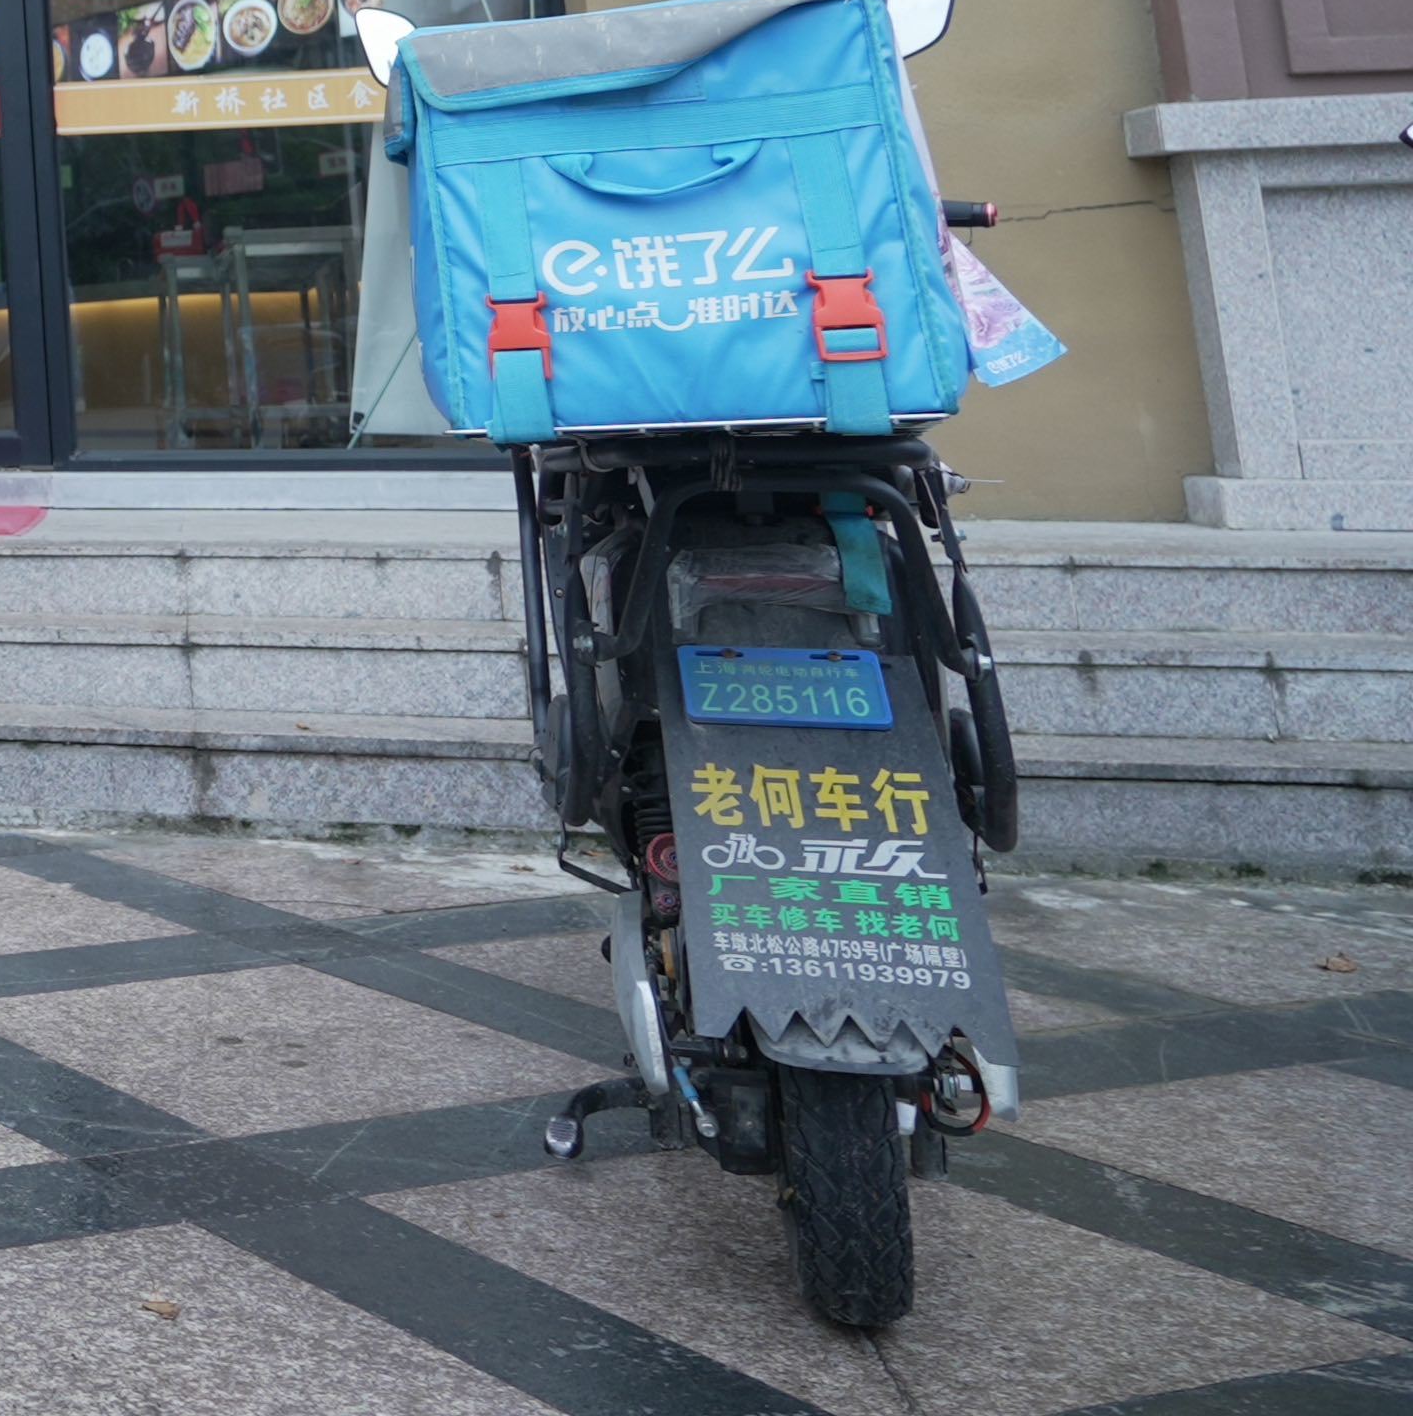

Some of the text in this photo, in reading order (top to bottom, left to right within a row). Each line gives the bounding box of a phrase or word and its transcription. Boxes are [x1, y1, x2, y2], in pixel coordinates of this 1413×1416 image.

[172, 80, 380, 117] 新桥社区食
[612, 226, 795, 290] 饿了么
[552, 290, 799, 333] 放心点 准时达
[699, 683, 870, 717] Z285116
[691, 762, 930, 836] 老何车行
[707, 874, 953, 910] 厂家直销
[710, 903, 961, 942] 买车修车 找老何
[713, 931, 968, 968] 车墩北松公路4759号(广场隔壁)
